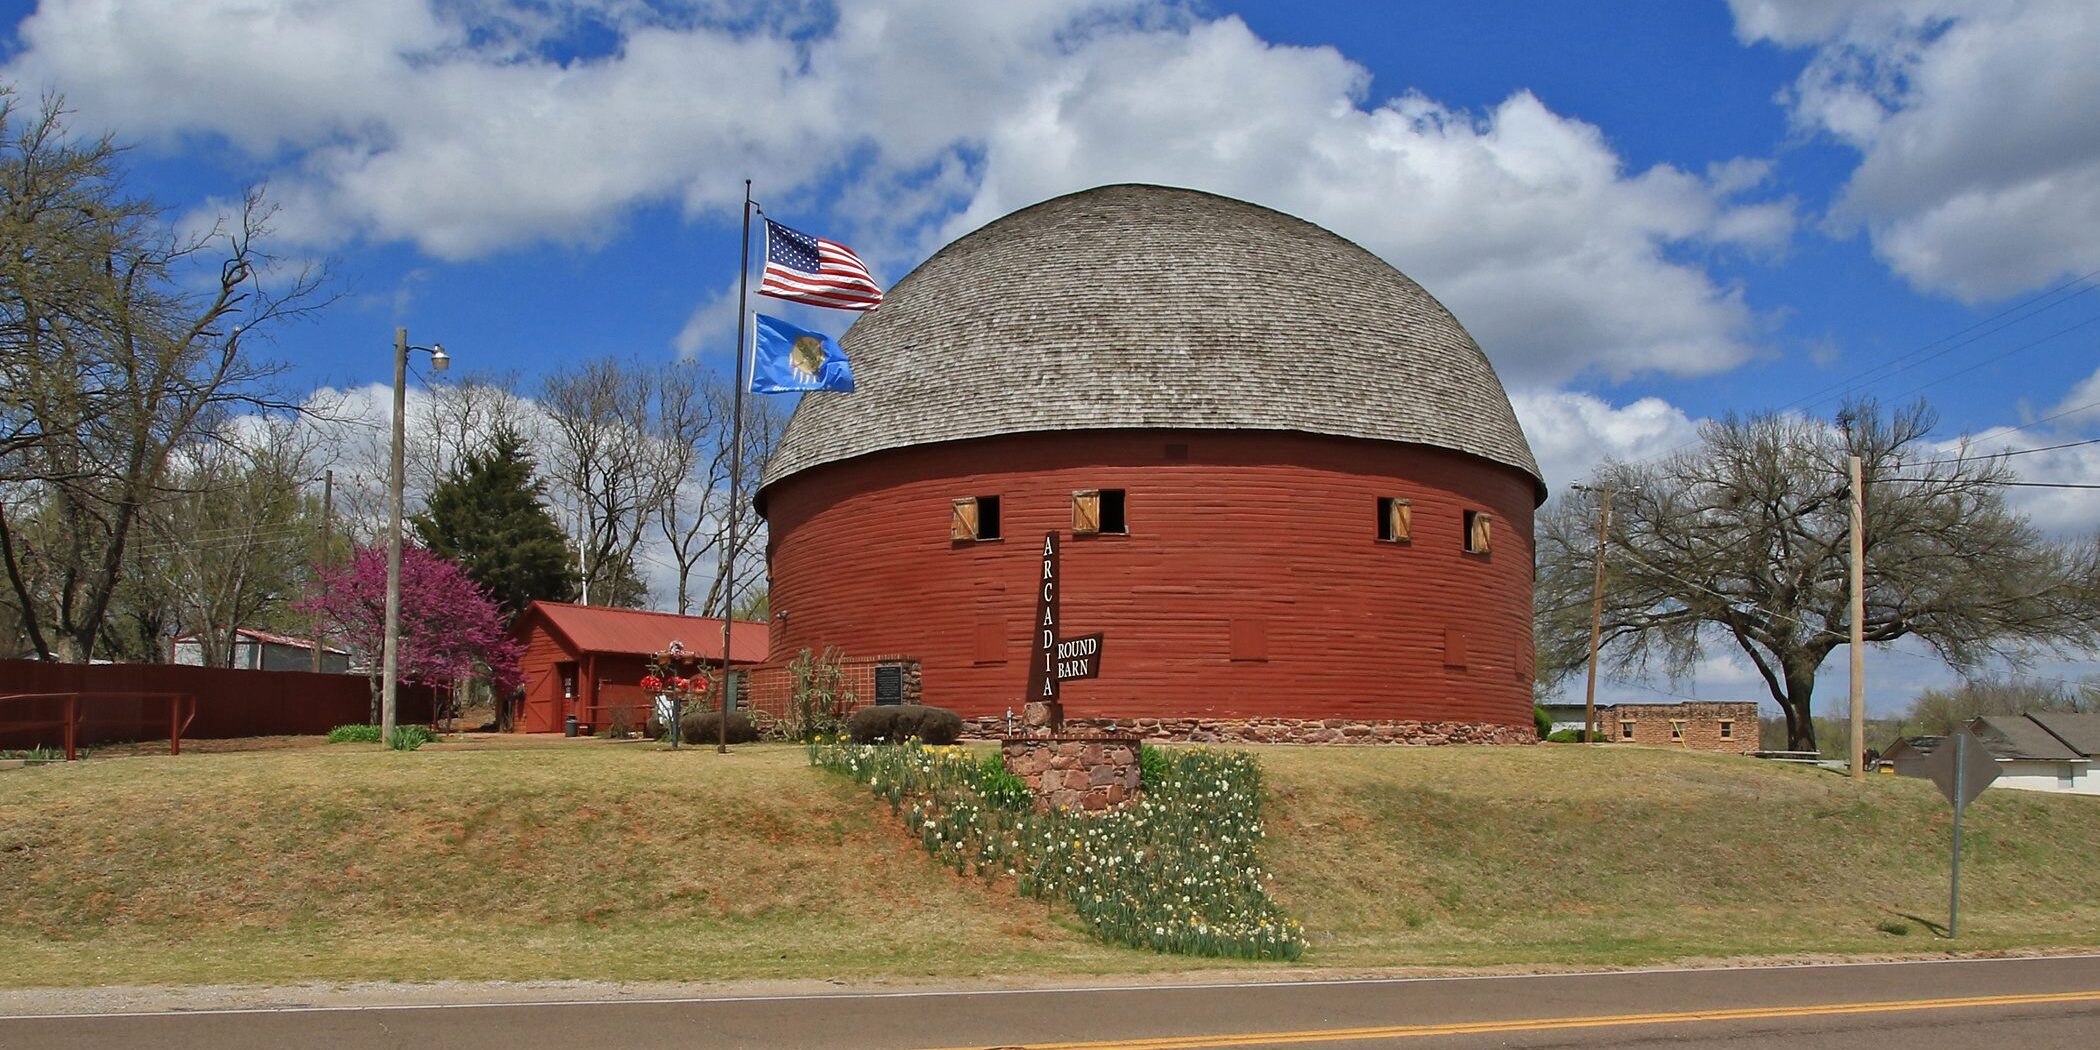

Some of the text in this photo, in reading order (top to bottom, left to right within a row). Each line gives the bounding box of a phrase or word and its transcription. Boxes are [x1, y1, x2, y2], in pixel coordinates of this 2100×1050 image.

[1043, 536, 1053, 696] ARCADIA
[1057, 638, 1097, 660] ROUND
[1057, 658, 1089, 679] BARN
